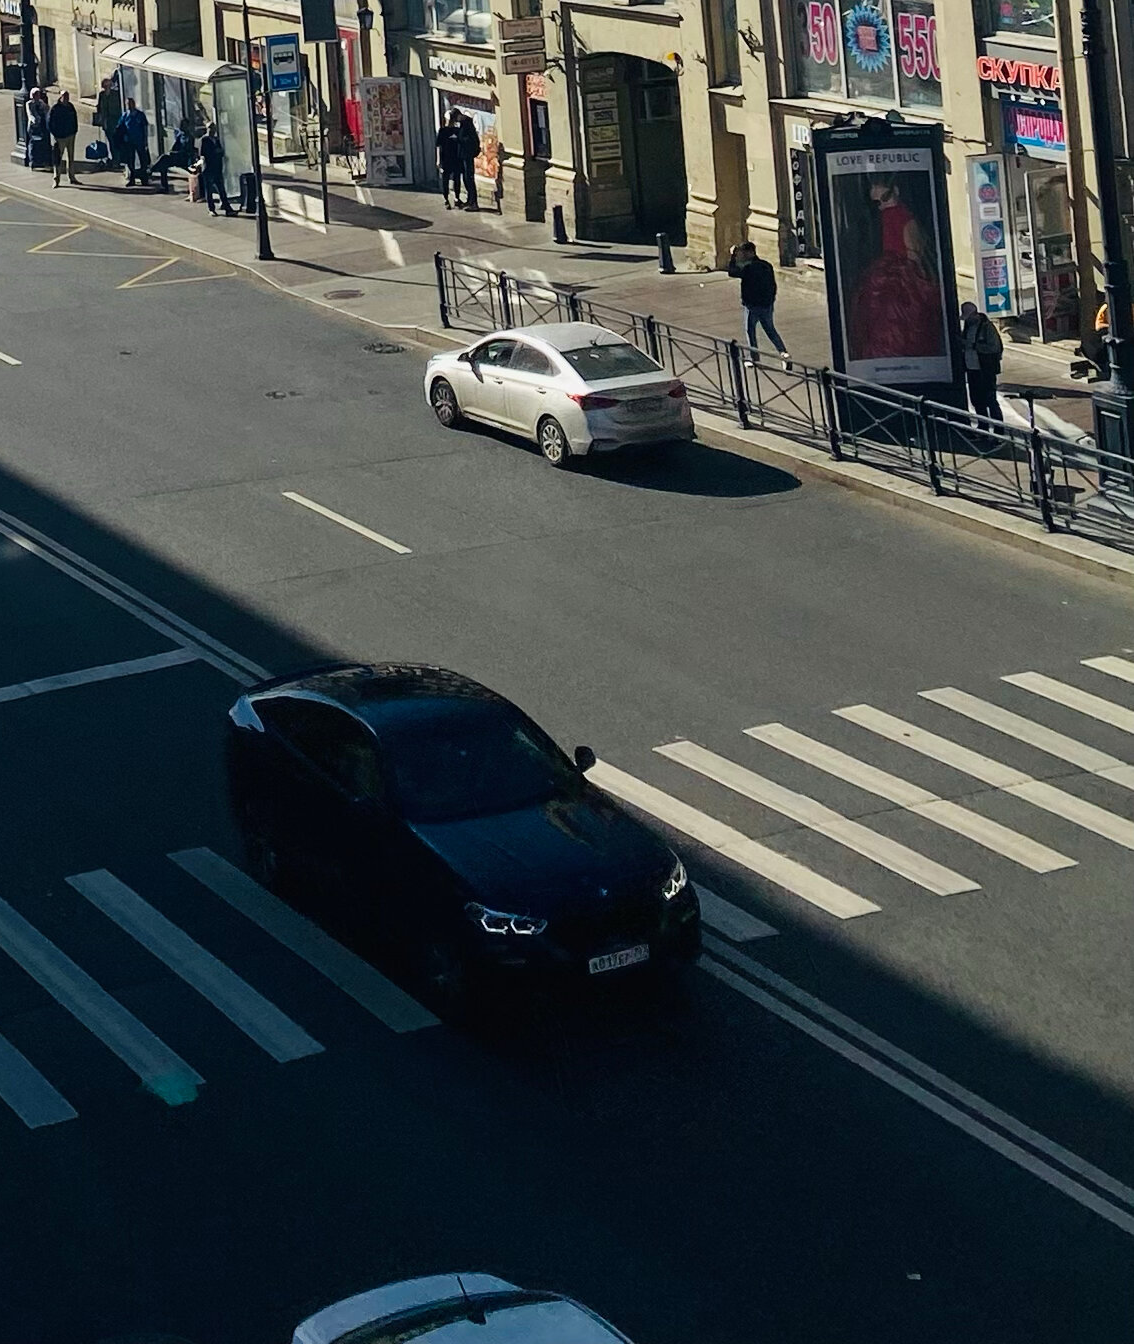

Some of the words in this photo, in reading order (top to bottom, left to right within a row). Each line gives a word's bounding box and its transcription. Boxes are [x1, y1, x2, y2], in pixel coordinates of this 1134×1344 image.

[429, 56, 475, 78] ПРОДУКТЫ
[476, 66, 487, 80] 24
[977, 56, 1061, 91] СКУПКА
[792, 124, 811, 145] ЦВ
[836, 155, 862, 166] LOVE
[869, 153, 920, 163] REPUBLIC
